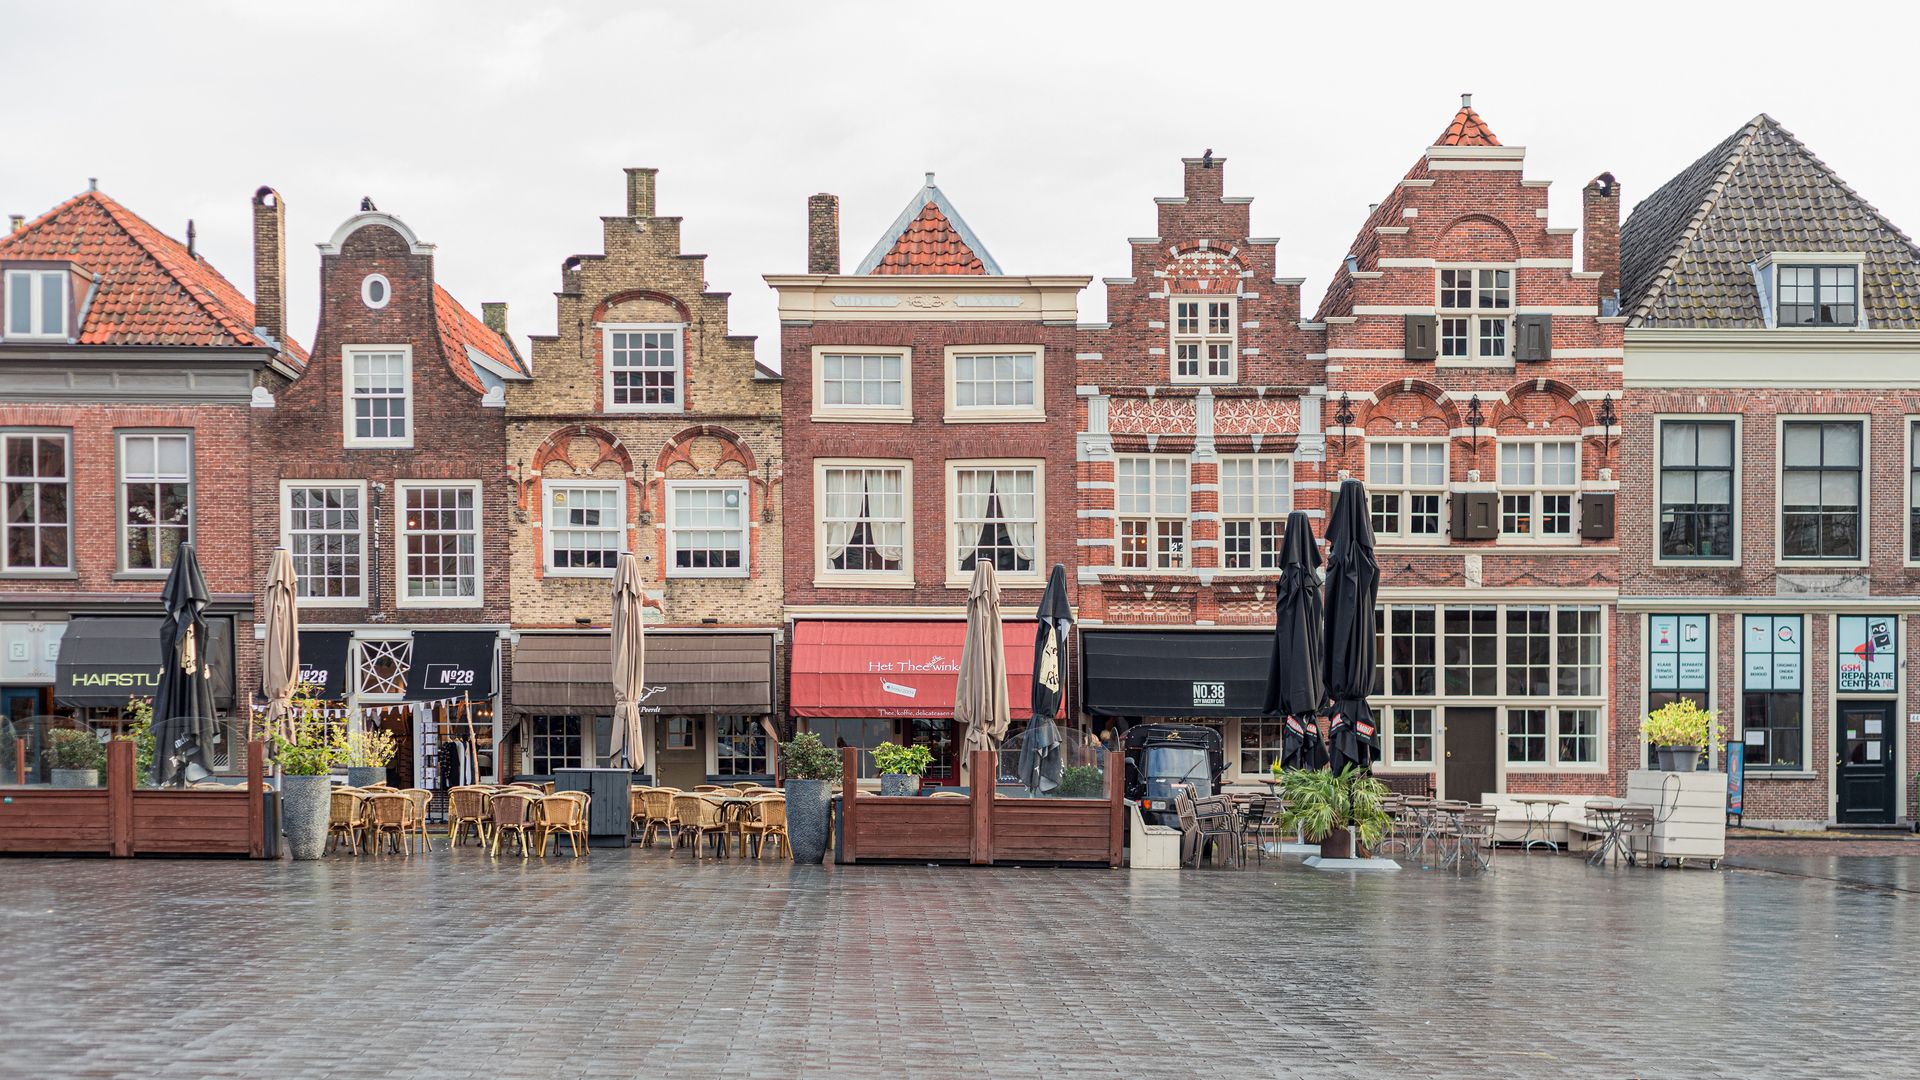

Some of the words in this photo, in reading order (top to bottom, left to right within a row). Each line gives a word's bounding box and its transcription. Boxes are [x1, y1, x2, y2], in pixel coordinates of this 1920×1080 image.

[868, 661, 894, 672] Het
[1840, 664, 1861, 672] GSM
[1841, 672, 1893, 680] REPARATIE
[1193, 685, 1225, 698] NO.38
